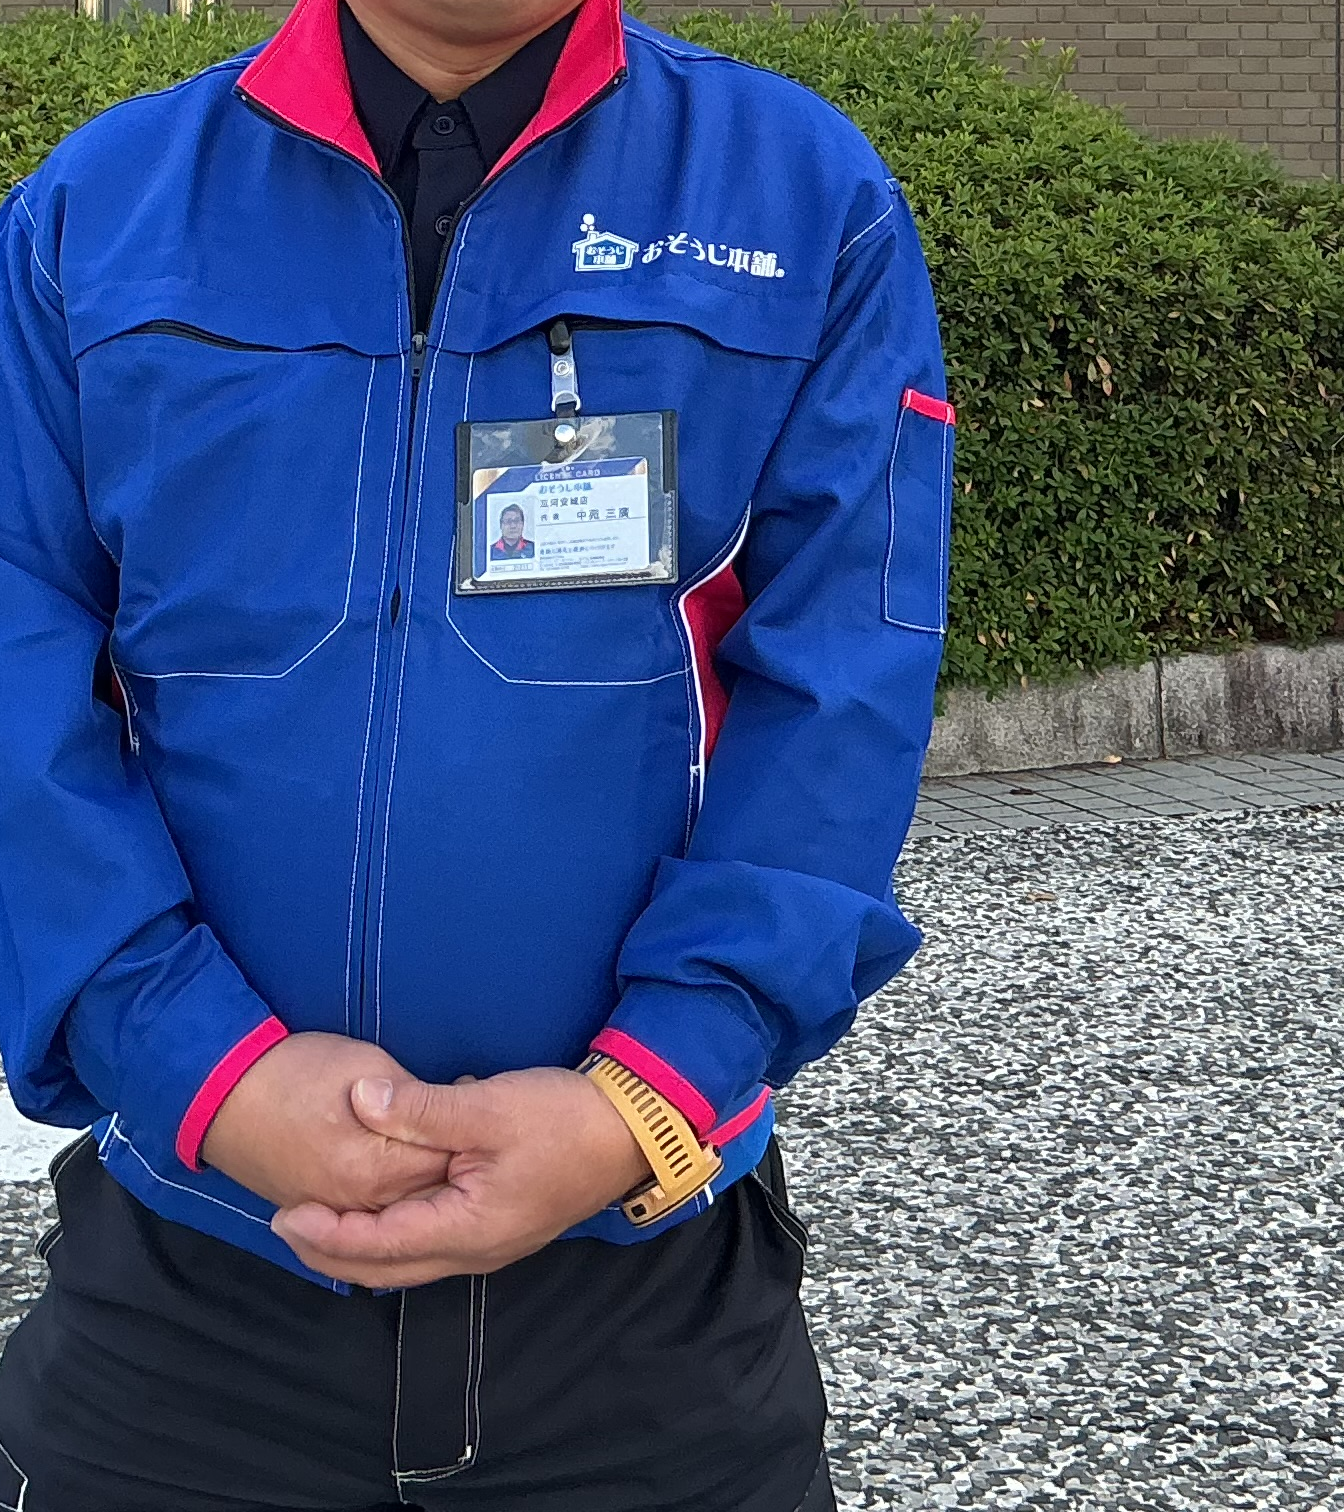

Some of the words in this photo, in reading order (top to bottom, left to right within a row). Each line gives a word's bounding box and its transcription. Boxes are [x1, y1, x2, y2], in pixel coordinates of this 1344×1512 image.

[642, 232, 779, 278] おそうじ本舗
